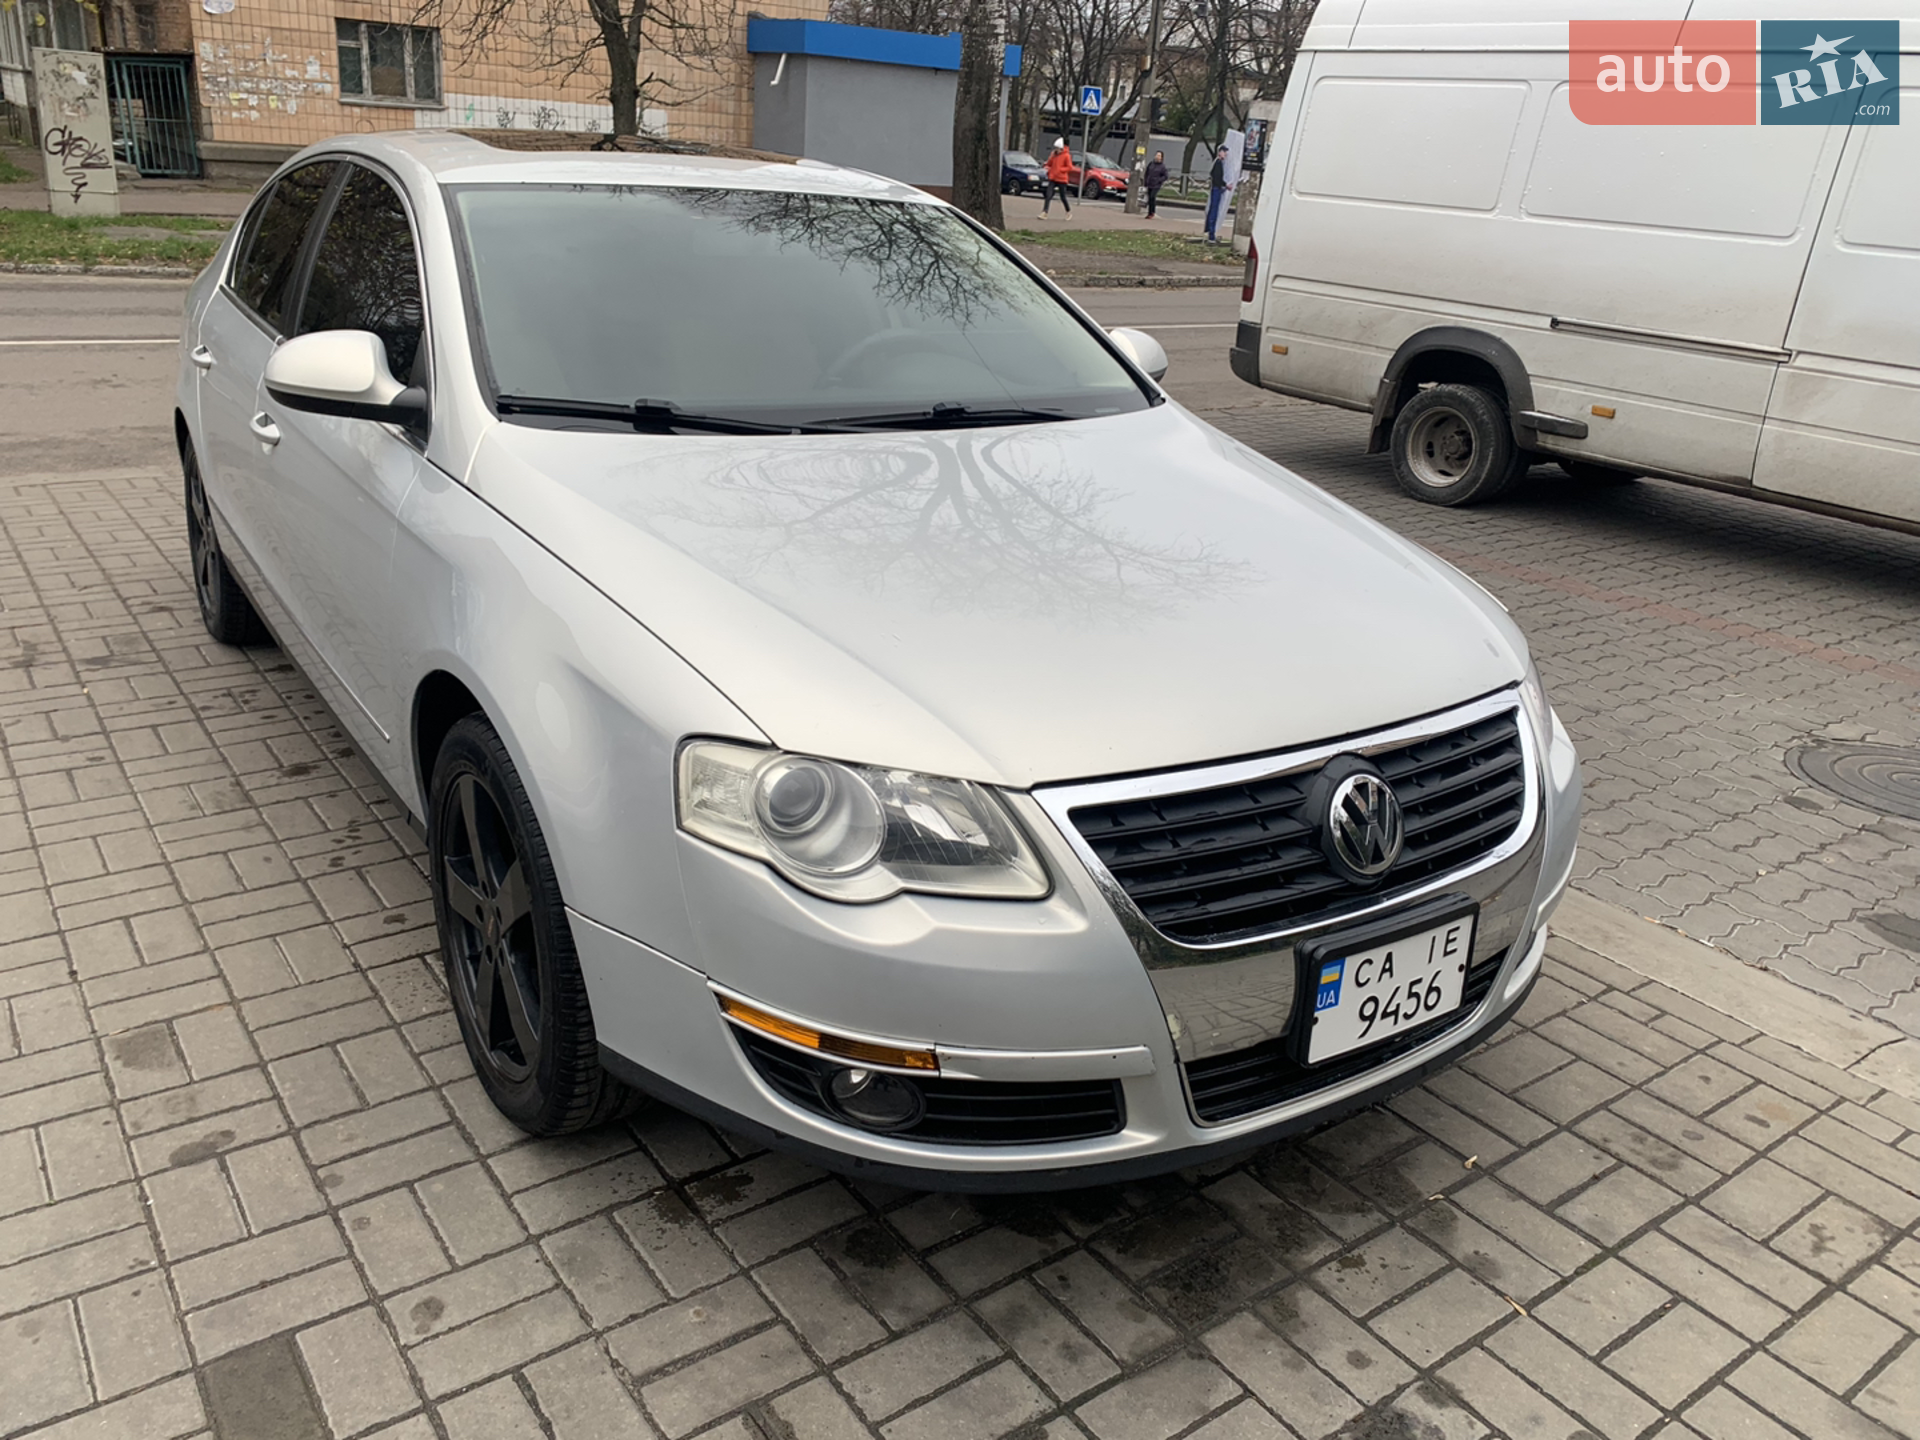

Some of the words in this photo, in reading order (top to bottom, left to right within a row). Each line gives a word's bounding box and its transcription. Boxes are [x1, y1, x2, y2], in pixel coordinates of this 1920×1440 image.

[1355, 951, 1394, 988] CA
[1427, 926, 1461, 964] IE
[1316, 990, 1336, 1008] UA
[1357, 970, 1442, 1039] 9456
